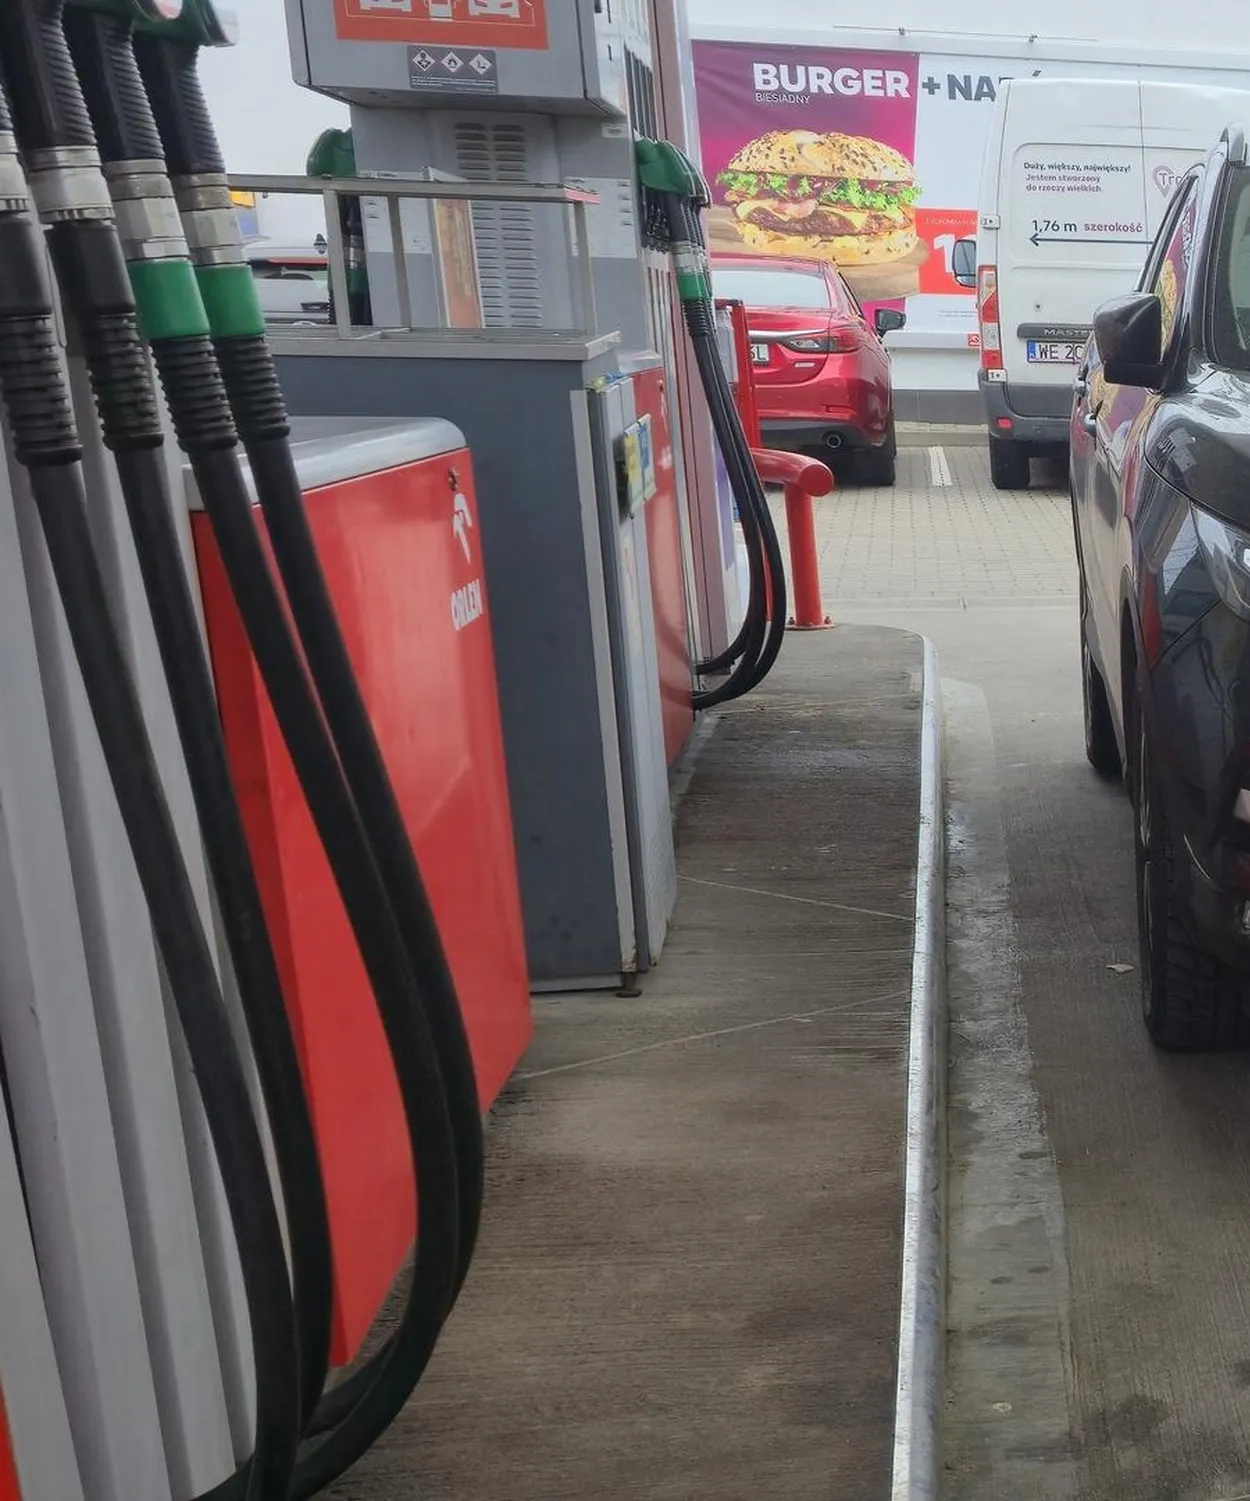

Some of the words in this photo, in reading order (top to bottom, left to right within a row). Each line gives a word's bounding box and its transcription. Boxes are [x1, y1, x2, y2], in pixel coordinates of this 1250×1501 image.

[752, 63, 911, 99] BURGER
[755, 92, 811, 104] BIESIADNY
[1031, 219, 1060, 233] 1,76
[1063, 222, 1078, 232] m
[1083, 222, 1143, 233] szerokość
[1038, 344, 1059, 359] WE
[450, 579, 484, 631] ORLEN
